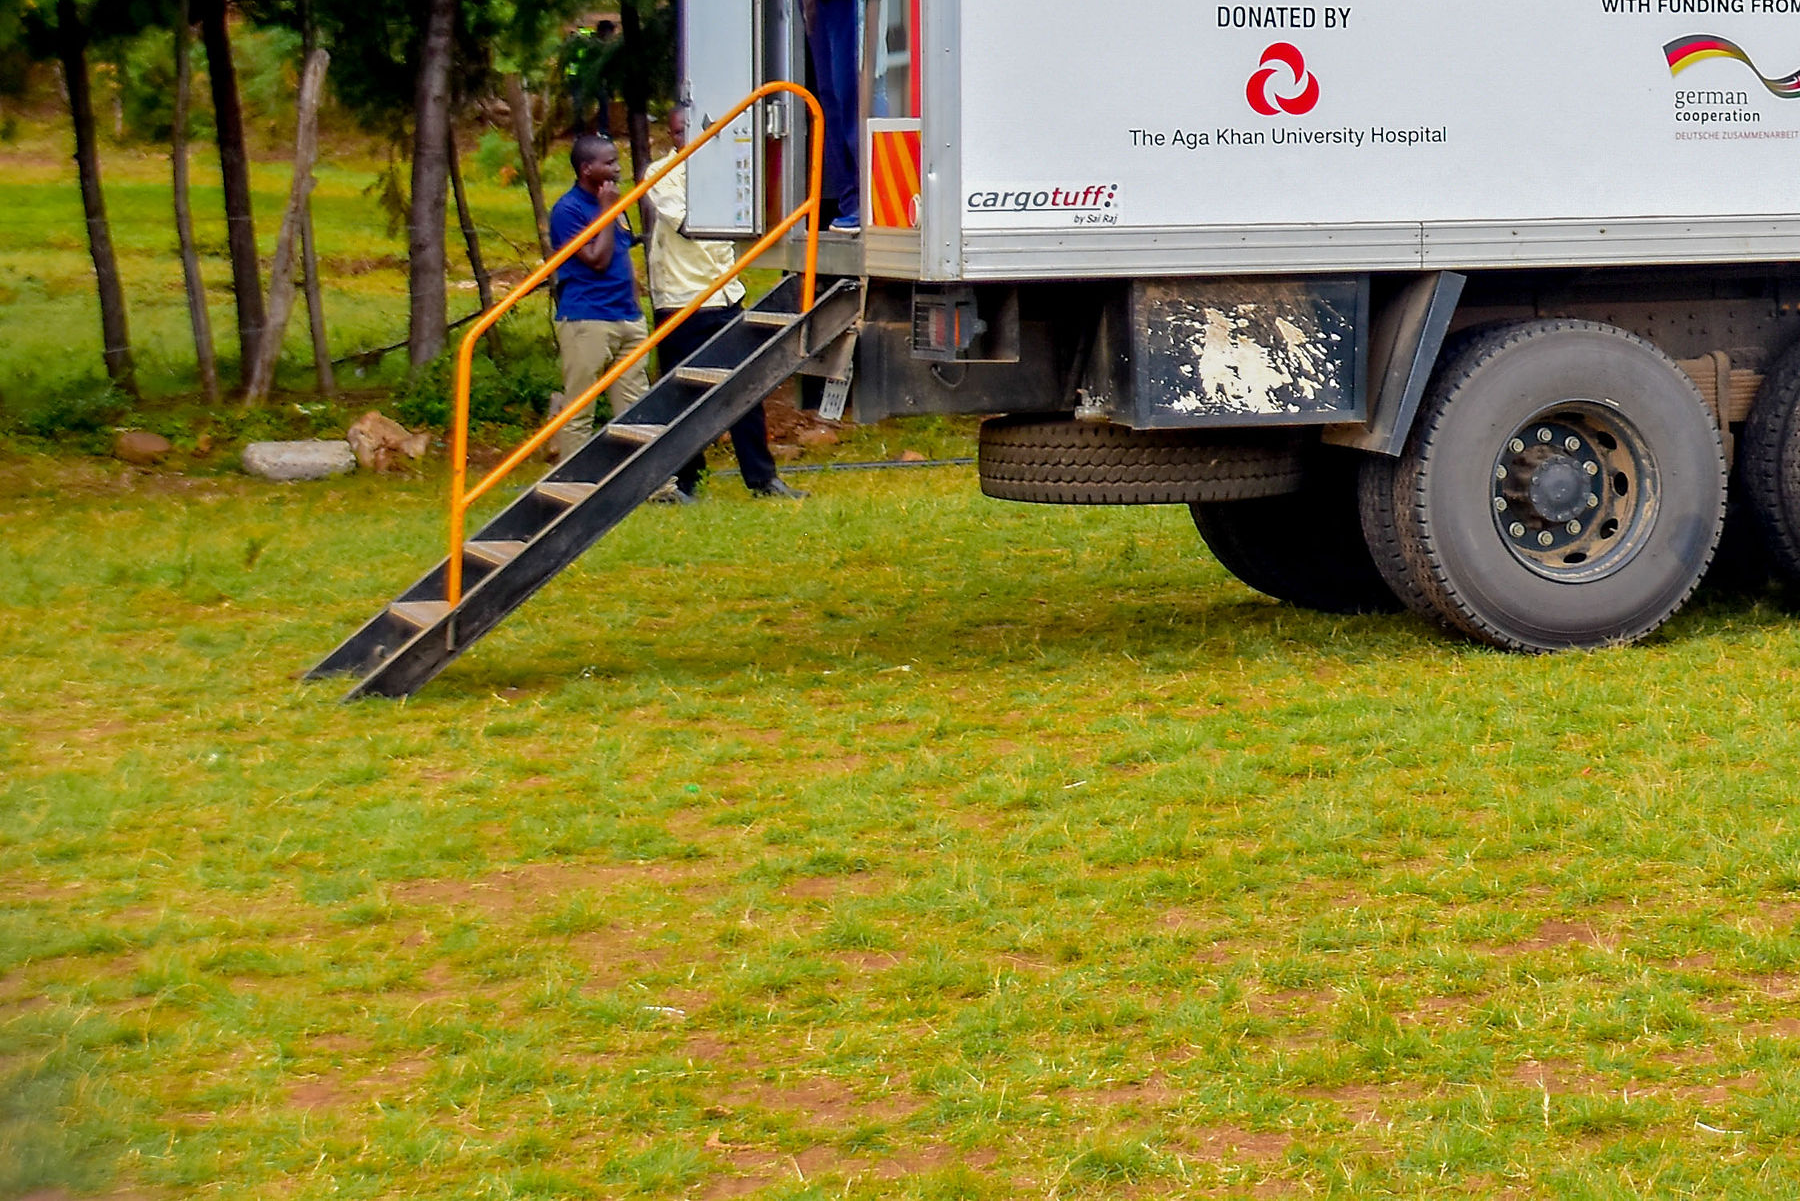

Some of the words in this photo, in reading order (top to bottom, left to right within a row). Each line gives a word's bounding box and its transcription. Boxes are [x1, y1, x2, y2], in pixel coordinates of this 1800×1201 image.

[1218, 7, 1315, 27] DONATED
[1325, 8, 1351, 28] BY
[1675, 90, 1748, 108] german
[1675, 109, 1760, 125] cooperation
[1129, 130, 1165, 145] The
[1172, 130, 1209, 149] Aga
[1217, 129, 1264, 144] Khan
[1272, 127, 1364, 147] University
[1372, 127, 1446, 146] Hospital
[1675, 131, 1719, 140] DEUTSCHE
[1722, 130, 1799, 139] ZUSAMMENARBEIT
[1074, 215, 1084, 224] by
